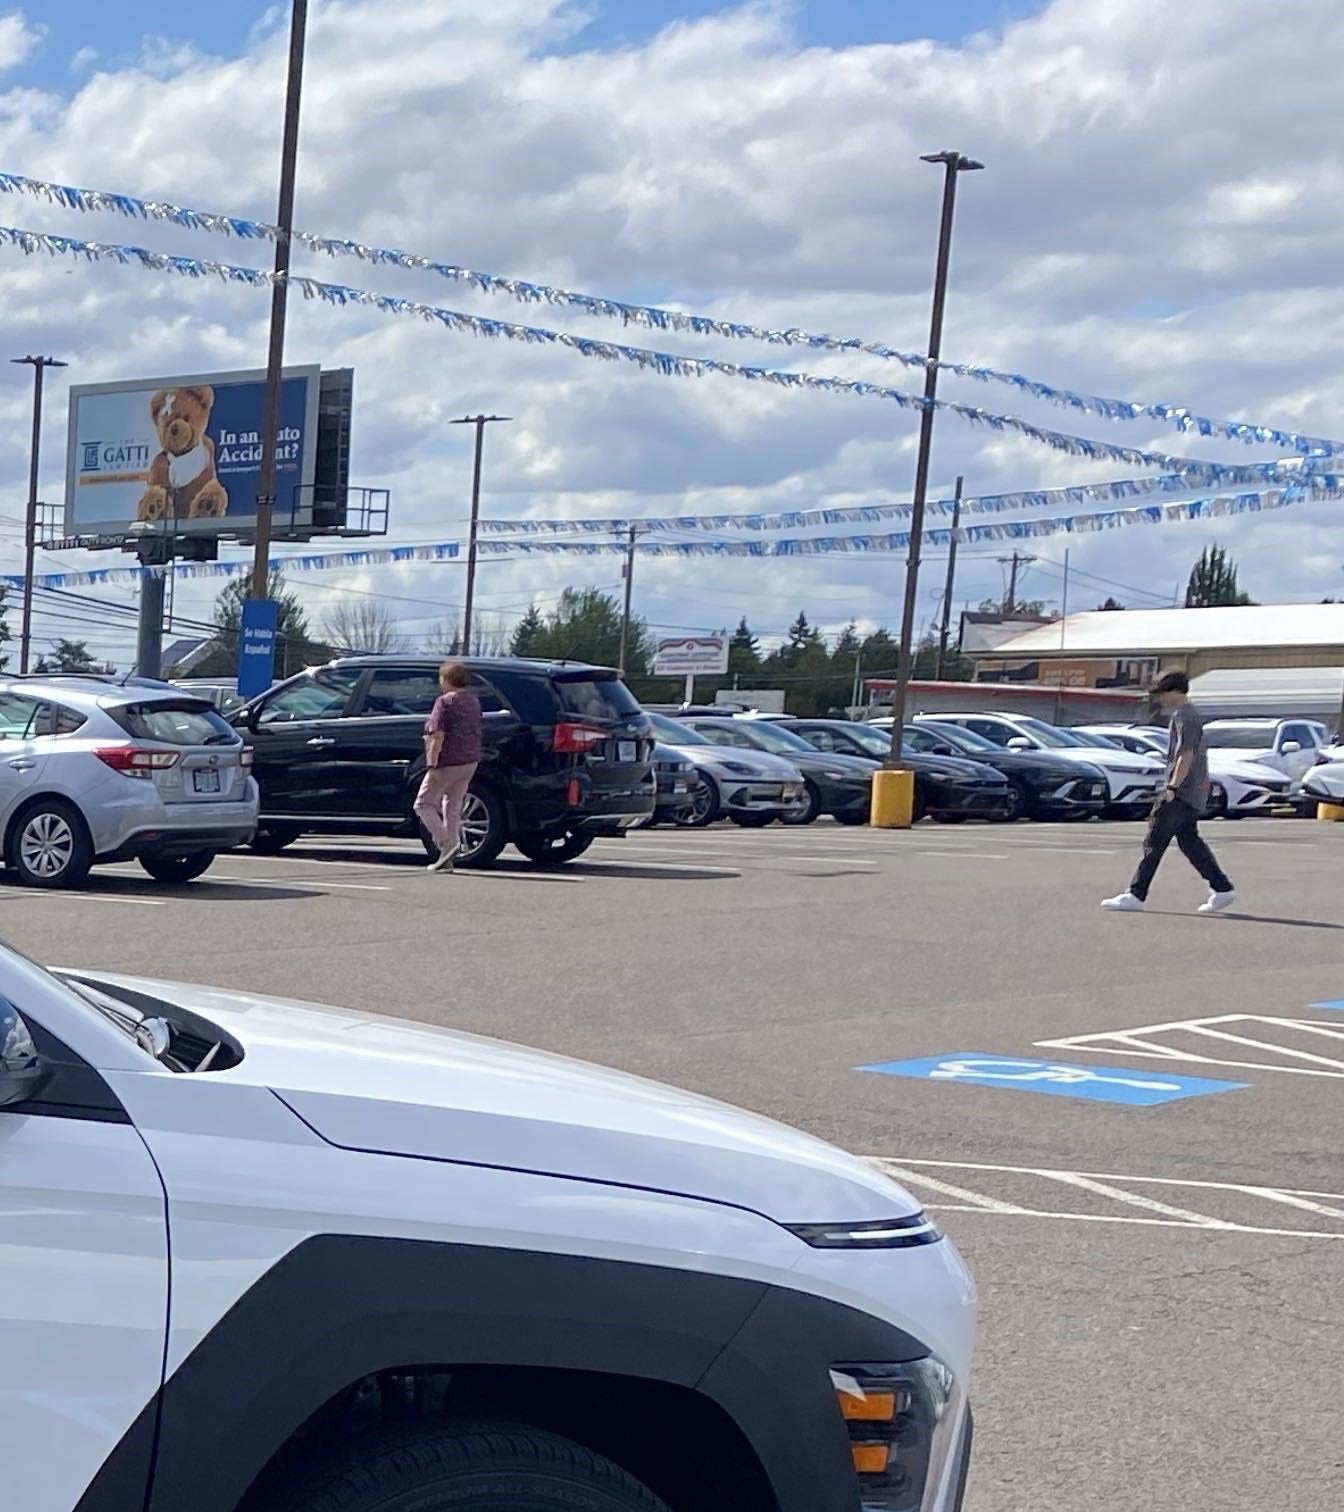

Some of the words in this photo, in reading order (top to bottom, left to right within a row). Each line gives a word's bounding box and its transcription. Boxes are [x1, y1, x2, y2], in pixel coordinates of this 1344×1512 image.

[219, 430, 236, 445] In
[240, 432, 258, 444] an
[103, 445, 149, 463] GATTI
[218, 443, 299, 463] Accidnt?
